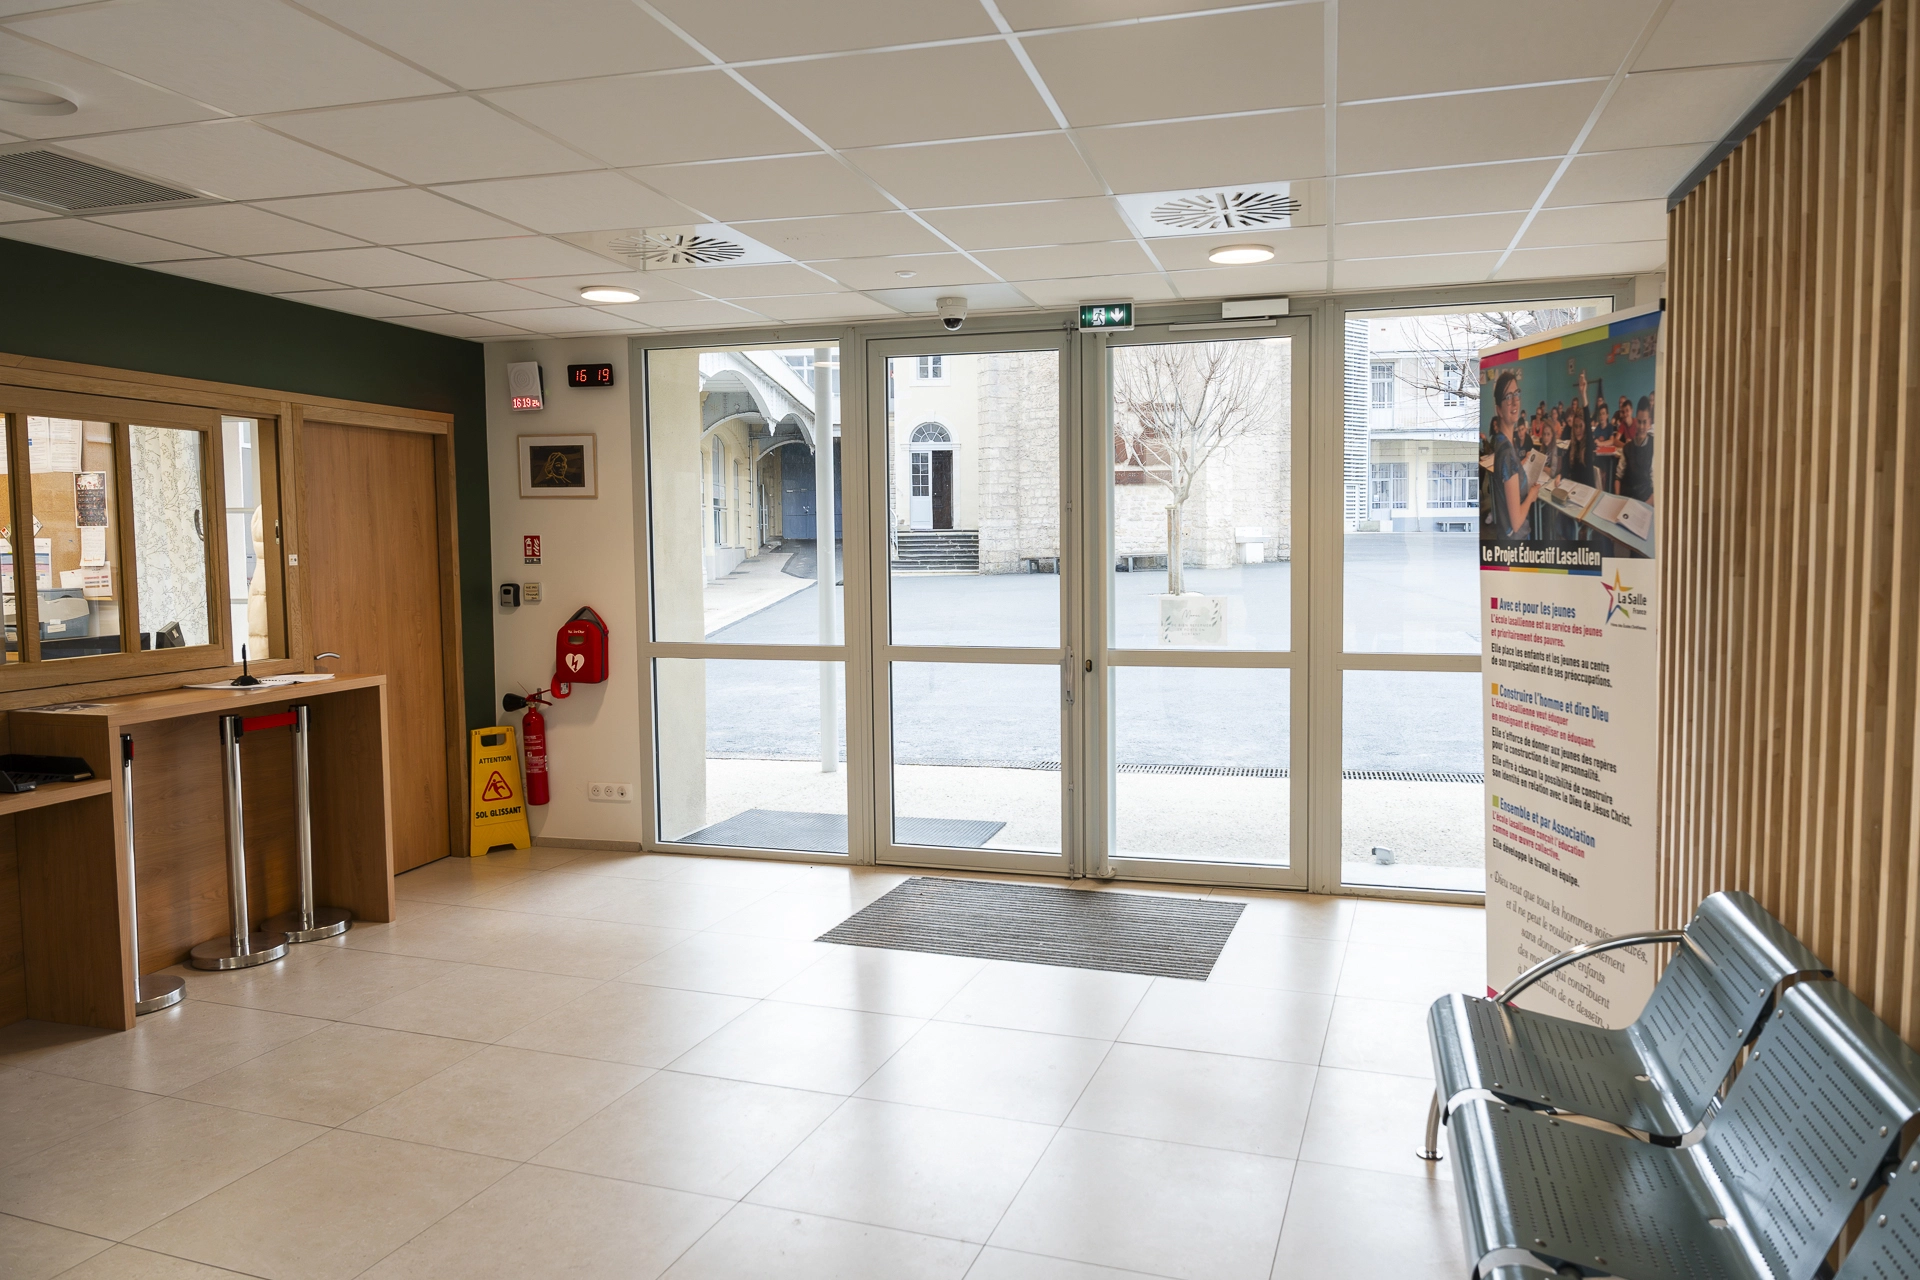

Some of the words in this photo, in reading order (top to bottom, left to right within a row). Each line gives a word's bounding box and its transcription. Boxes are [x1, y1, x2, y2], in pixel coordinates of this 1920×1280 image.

[576, 370, 587, 382] 16
[598, 369, 609, 381] 19
[513, 399, 521, 408] 16
[523, 398, 531, 408] 19
[1482, 546, 1492, 561] le
[1494, 547, 1518, 565] Projet
[1519, 543, 1555, 564] Éducatif
[1556, 548, 1600, 566] Lasallien
[1499, 598, 1513, 612] Avec
[1515, 600, 1521, 612] et
[1523, 603, 1539, 615] pour
[1540, 602, 1550, 615] les
[1552, 603, 1576, 619] jeunes
[1618, 593, 1626, 604] La
[1628, 593, 1647, 606] Salle
[1491, 614, 1507, 624] L'école
[1508, 614, 1534, 627] lasallienne
[1536, 621, 1544, 629] est
[1552, 622, 1570, 633] service
[1572, 624, 1582, 634] des
[1583, 626, 1602, 637] jeunes
[1497, 629, 1532, 643] prioritairement
[1534, 632, 1542, 643] des
[1544, 636, 1565, 647] pauvres.
[1492, 643, 1501, 653] Elle
[1502, 644, 1514, 656] place
[1515, 646, 1523, 656] les
[1524, 648, 1544, 661] enfants
[1546, 652, 1551, 661] et
[1561, 653, 1580, 667] jeunes
[1581, 660, 1589, 669] au
[1590, 660, 1610, 672] centre
[1492, 655, 1497, 665] de
[1499, 658, 1507, 667] son
[1508, 658, 1539, 673] organisation
[1541, 664, 1546, 674] et
[1547, 664, 1553, 675] de
[1554, 668, 1563, 677] ses
[1565, 667, 1612, 688] préoccupations.
[1492, 698, 1507, 709] L'école
[1509, 701, 1535, 717] lasallienne
[1536, 710, 1547, 720] veut
[1548, 711, 1568, 726] éduquer
[1500, 684, 1532, 704] Construire
[1535, 692, 1563, 712] l'homme
[1565, 701, 1573, 713] et
[1575, 701, 1589, 717] dire
[1592, 705, 1609, 722] Dieu
[1499, 714, 1523, 729] enseignant
[1524, 720, 1529, 730] et
[1531, 721, 1558, 736] évangéliser
[1560, 731, 1566, 740] en
[479, 755, 511, 764] ATTENTION
[1492, 726, 1501, 737] Elle
[1502, 728, 1523, 745] s'efforce
[1524, 734, 1530, 744] de
[1532, 737, 1550, 751] donner
[1551, 744, 1560, 756] aux
[1561, 746, 1580, 762] jeunes
[1582, 753, 1592, 765] des
[1593, 755, 1617, 773] repères
[1492, 740, 1502, 751] pour
[1504, 742, 1508, 752] la
[1509, 744, 1541, 763] construction
[1543, 754, 1549, 765] de
[1550, 755, 1560, 769] leur
[1561, 762, 1600, 782] personnalité.
[1492, 755, 1501, 766] Elle
[1503, 758, 1513, 771] offre
[1514, 762, 1517, 771] à
[1518, 764, 1537, 779] chacun
[1539, 770, 1543, 780] la
[1545, 771, 1572, 791] possibilité
[1573, 781, 1580, 792] de
[1582, 784, 1613, 805] construire
[475, 811, 488, 819] SOL
[490, 806, 521, 817] GLISSANT
[1492, 768, 1501, 779] son
[1502, 770, 1519, 785] identité
[1521, 778, 1527, 787] en
[1528, 779, 1548, 796] relation
[1550, 786, 1561, 800] avec
[1562, 791, 1568, 803] le
[1569, 793, 1582, 809] Dieu
[1584, 799, 1591, 811] de
[1592, 799, 1609, 818] Jésus
[1611, 809, 1632, 827] Christ.
[1492, 811, 1508, 825] L'école
[1509, 817, 1535, 837] lasallienne
[1555, 835, 1585, 858] l'éducation
[1500, 797, 1530, 821] Ensemble
[1532, 811, 1539, 825] et
[1540, 815, 1551, 829] par
[1552, 818, 1596, 848] Association
[1493, 824, 1508, 838] comme
[1535, 839, 1560, 861] collective.
[1493, 838, 1502, 850] Elle
[1503, 841, 1527, 863] développe
[1528, 853, 1533, 864] le
[1535, 856, 1550, 874] travail
[1552, 865, 1558, 876] en
[1559, 868, 1580, 887] équipe.
[1494, 871, 1508, 889] Dieu
[1510, 882, 1522, 896] veut
[1523, 890, 1535, 902] que
[1537, 895, 1550, 910] tous
[1552, 900, 1560, 916] les
[1561, 905, 1592, 931] hommes
[1506, 900, 1511, 910] et
[1518, 906, 1526, 918] ne
[1527, 911, 1541, 926] peut
[1542, 916, 1547, 930] le
[1549, 926, 1573, 943] vouloir
[1521, 928, 1536, 942] sans
[1578, 961, 1605, 984] enfants
[1518, 943, 1528, 958] des
[1568, 976, 1610, 1009] contribuent
[1558, 989, 1566, 1003] de
[1567, 998, 1574, 1009] ce
